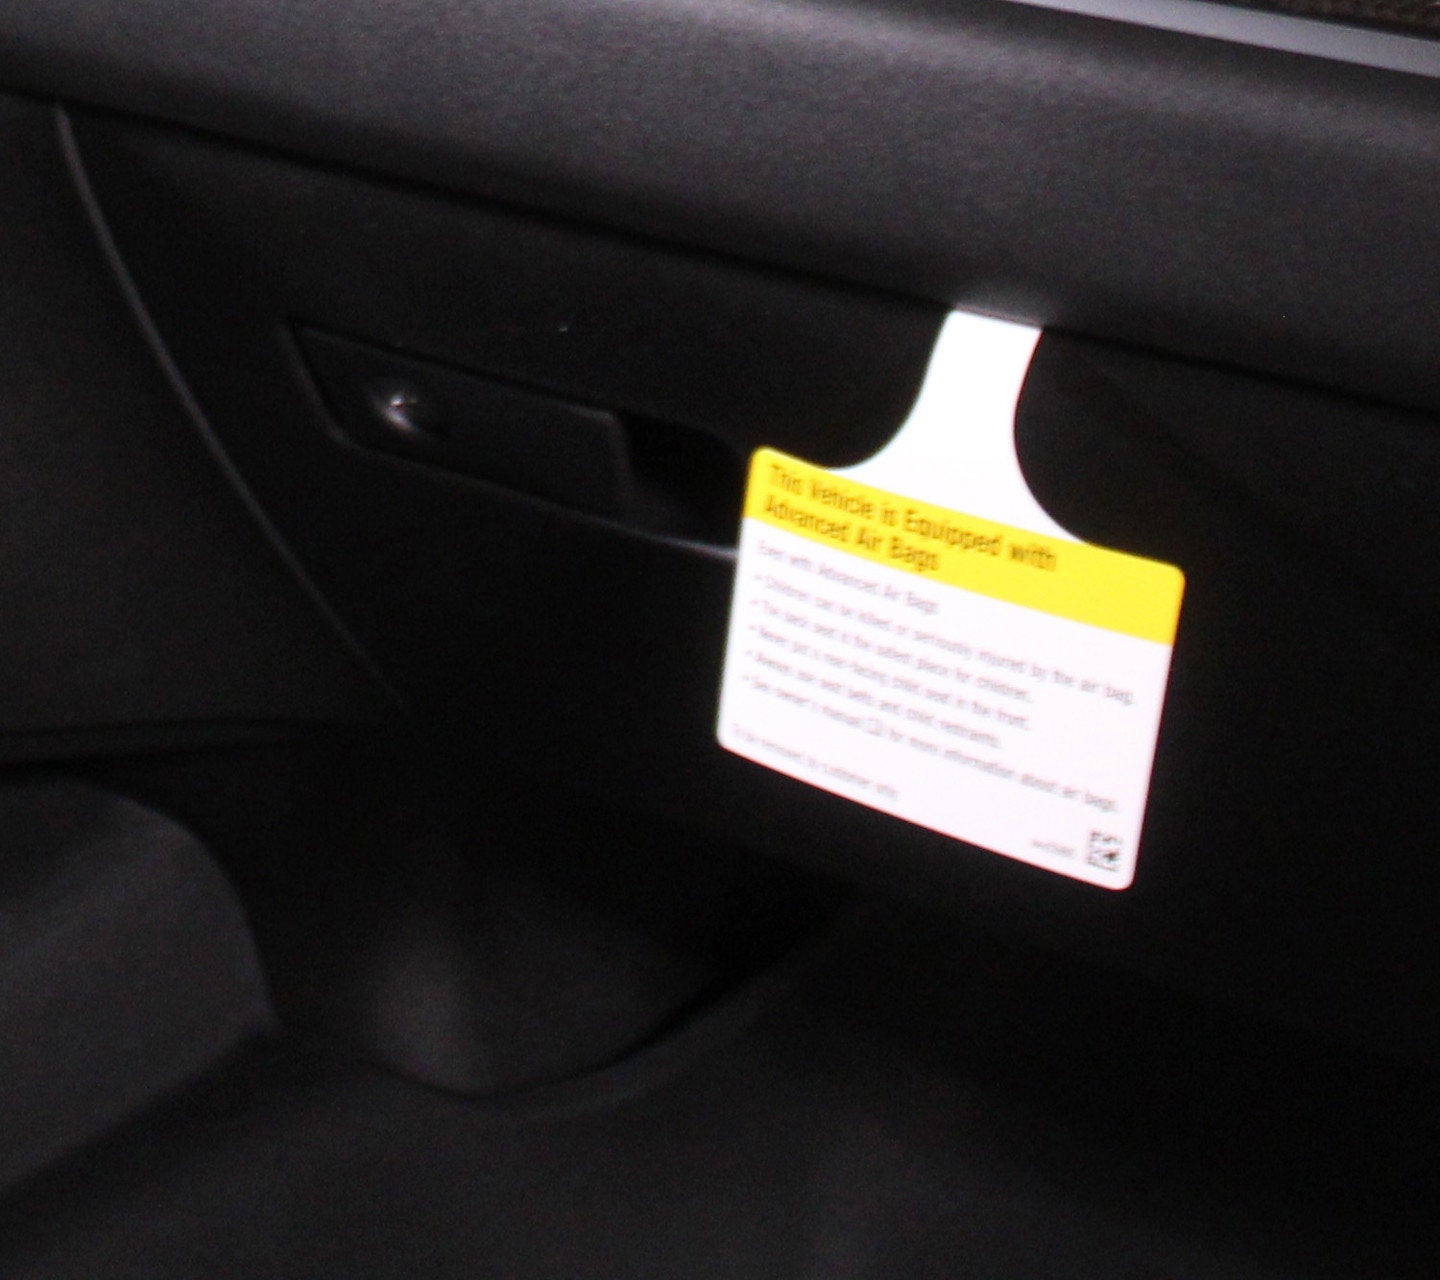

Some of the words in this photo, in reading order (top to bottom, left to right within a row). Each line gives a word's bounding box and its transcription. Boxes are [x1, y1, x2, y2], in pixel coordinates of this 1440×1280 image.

[764, 494, 850, 543] Advanced
[856, 526, 883, 551] Air
[888, 535, 941, 572] Bags
[771, 463, 803, 495] This
[810, 478, 872, 519] Vehicle
[880, 501, 897, 526] is
[903, 508, 1003, 556] Equipped
[1009, 541, 1057, 571] with
